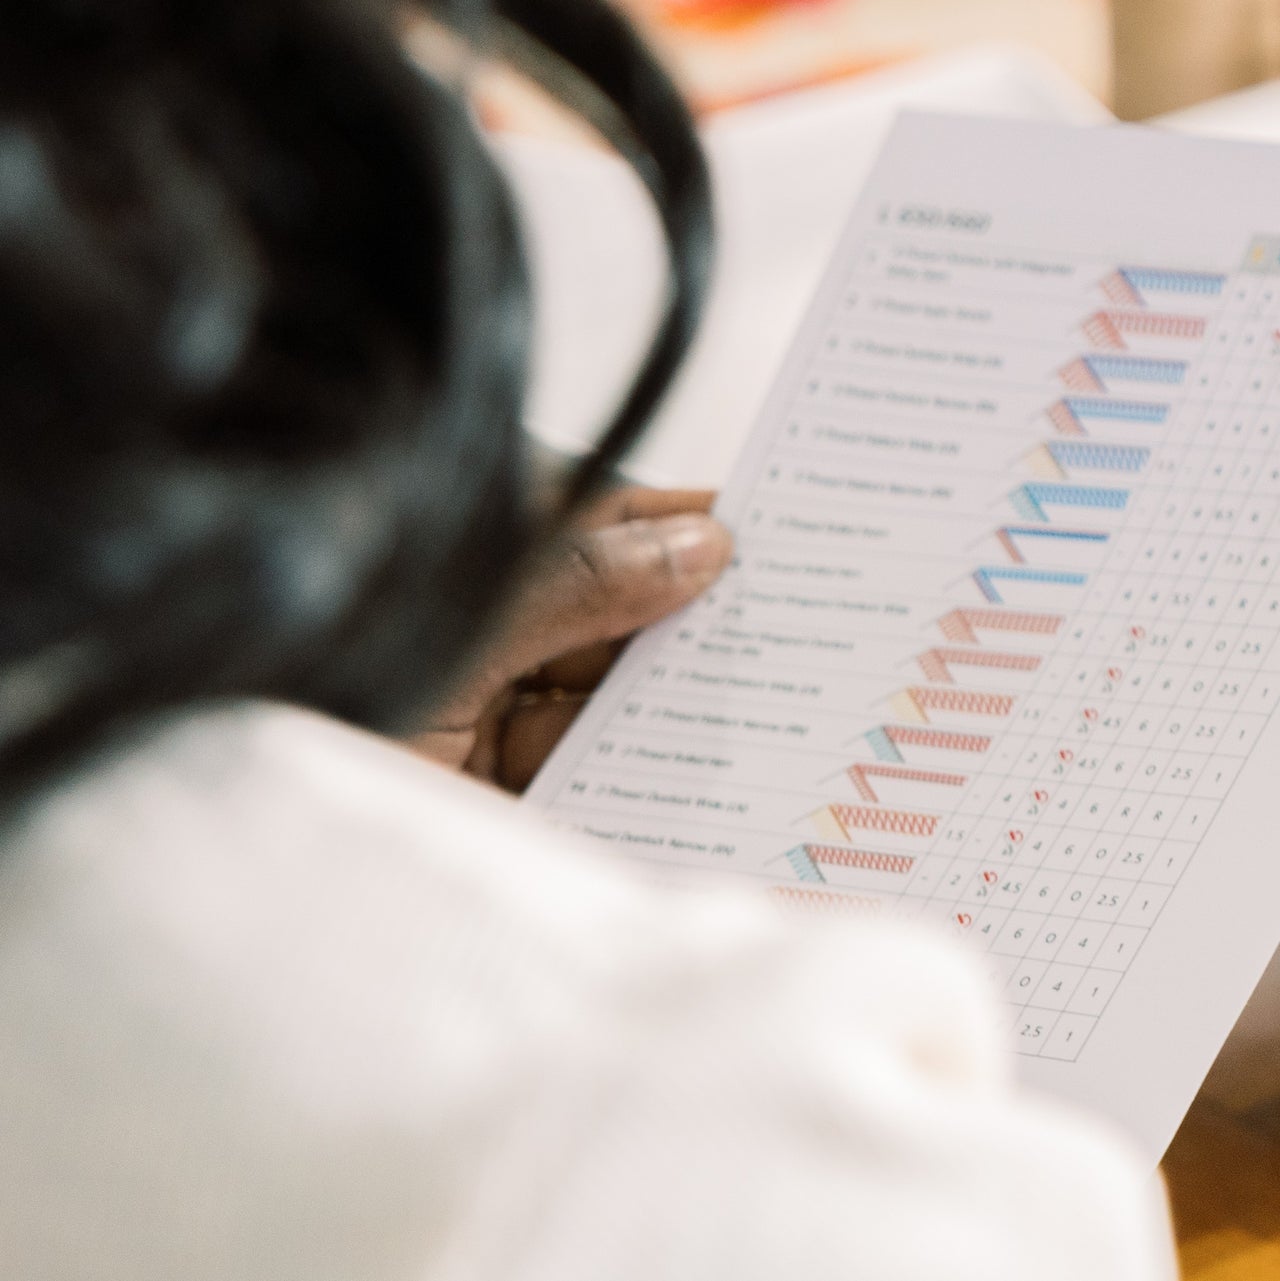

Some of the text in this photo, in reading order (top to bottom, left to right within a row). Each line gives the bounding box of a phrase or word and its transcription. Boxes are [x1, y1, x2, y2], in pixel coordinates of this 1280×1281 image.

[1002, 882, 1022, 894] 4.5
[1097, 894, 1118, 907] 2.5
[1020, 1024, 1042, 1038] 2.5
